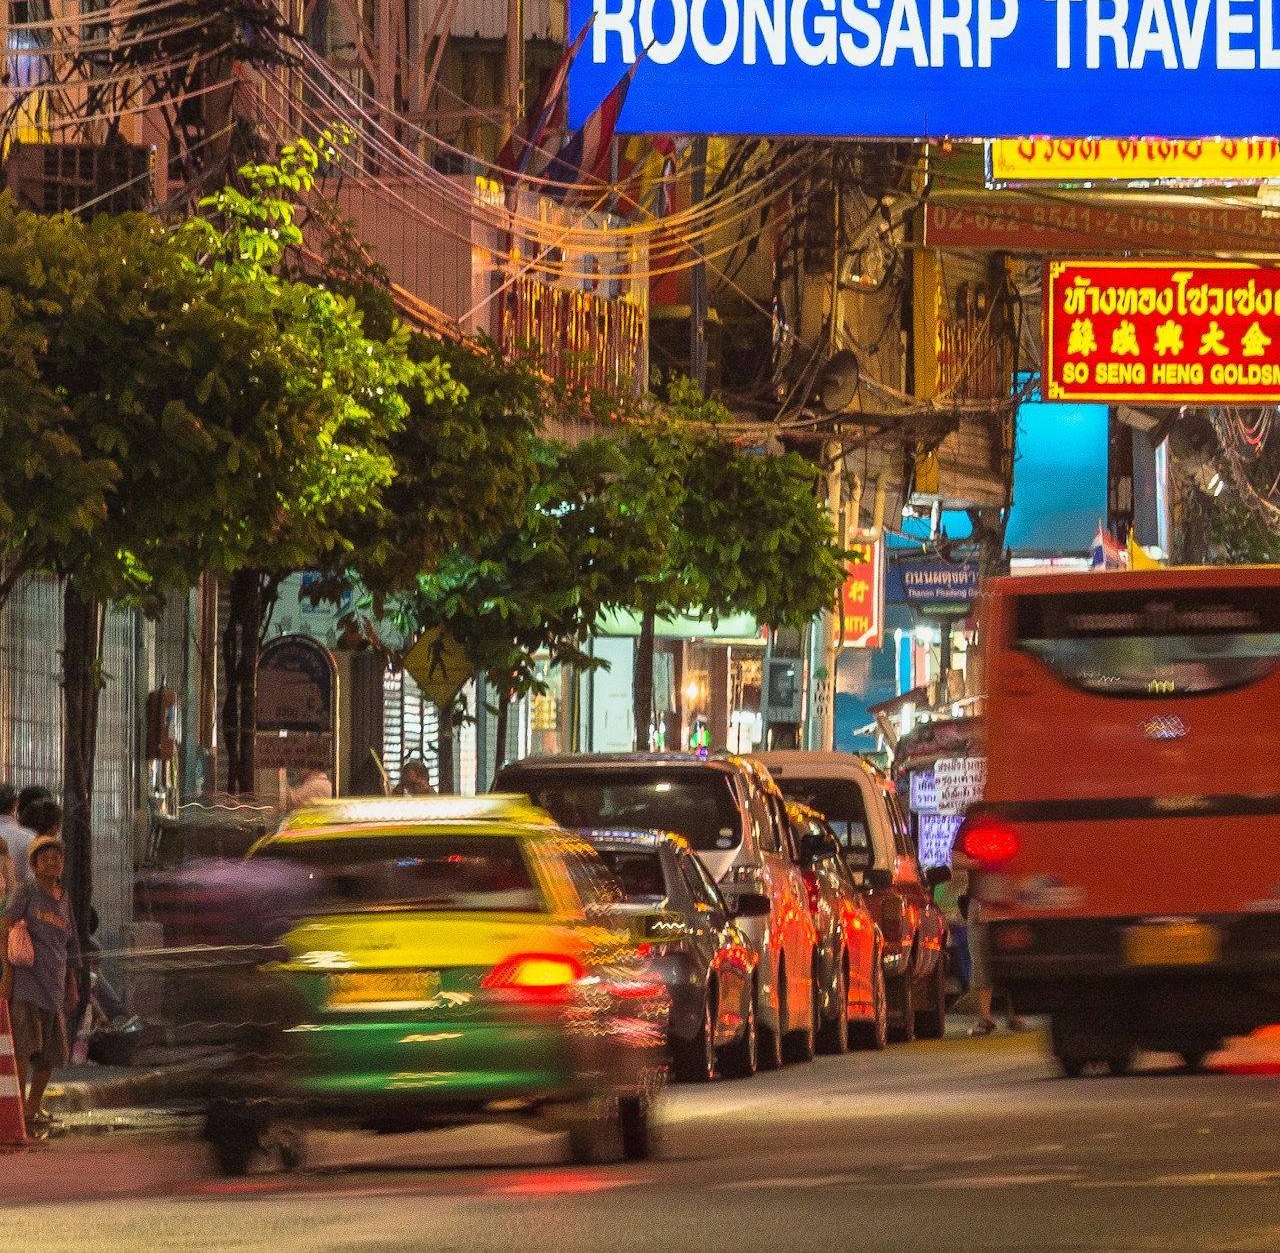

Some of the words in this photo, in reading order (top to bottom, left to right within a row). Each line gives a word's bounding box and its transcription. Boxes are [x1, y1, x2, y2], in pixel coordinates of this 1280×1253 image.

[1062, 362, 1090, 385] SO
[1095, 362, 1146, 385] SENG
[1152, 363, 1204, 385] HENG
